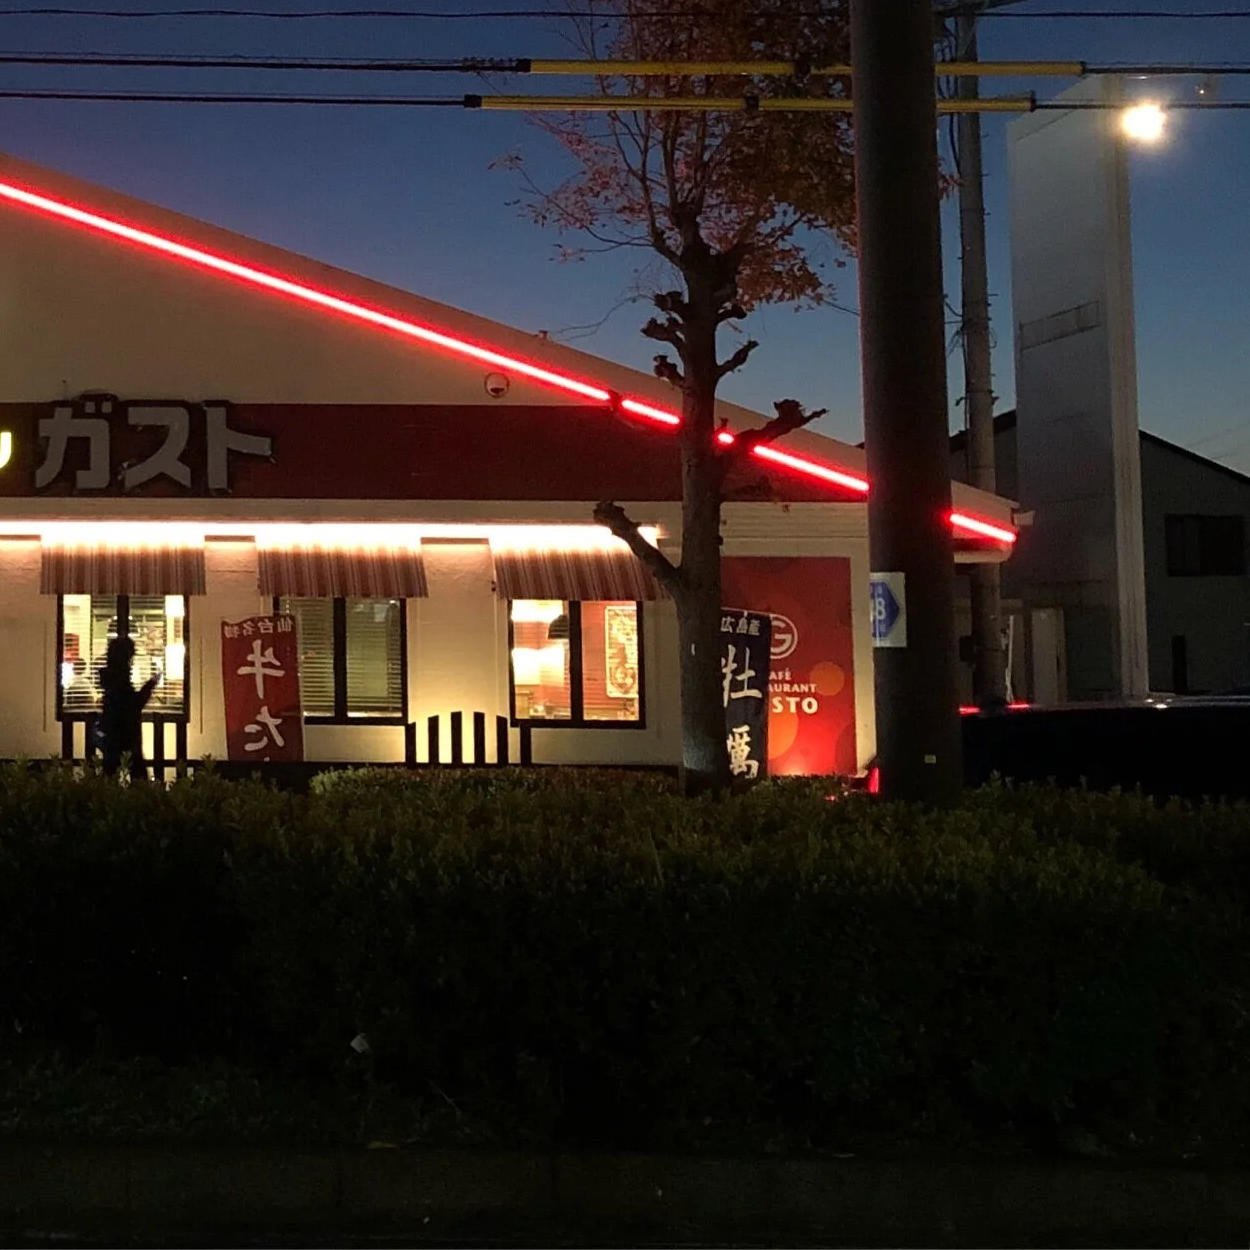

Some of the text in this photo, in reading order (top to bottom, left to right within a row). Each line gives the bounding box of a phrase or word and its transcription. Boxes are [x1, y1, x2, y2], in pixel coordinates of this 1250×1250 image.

[35, 401, 272, 490] ガスト
[768, 667, 792, 680] AFÉ
[771, 696, 818, 714] STO
